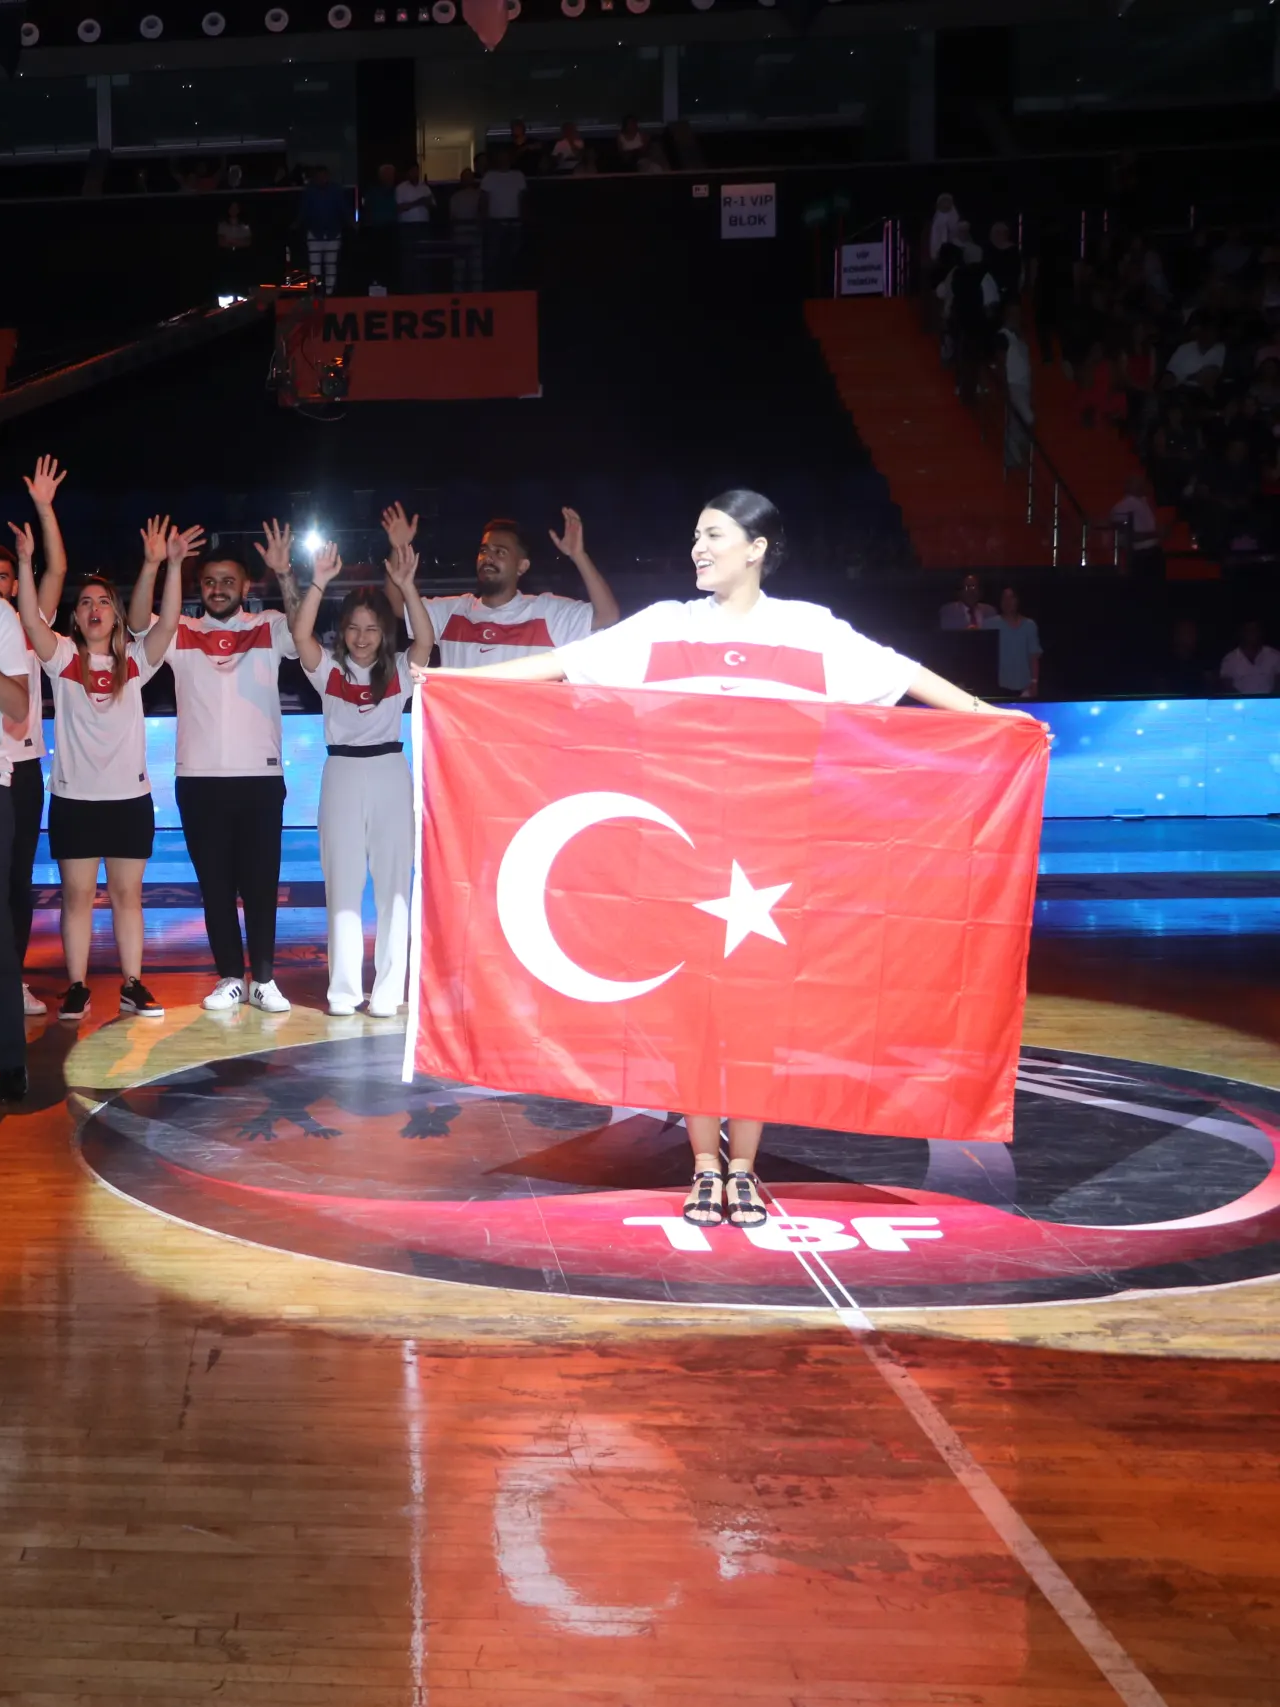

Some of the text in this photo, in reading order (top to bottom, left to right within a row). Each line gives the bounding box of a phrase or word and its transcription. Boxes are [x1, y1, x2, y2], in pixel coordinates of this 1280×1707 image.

[723, 196, 746, 208] R-1
[729, 214, 768, 227] BLOK
[322, 299, 493, 342] MERSİN
[622, 1216, 944, 1252] TBF
